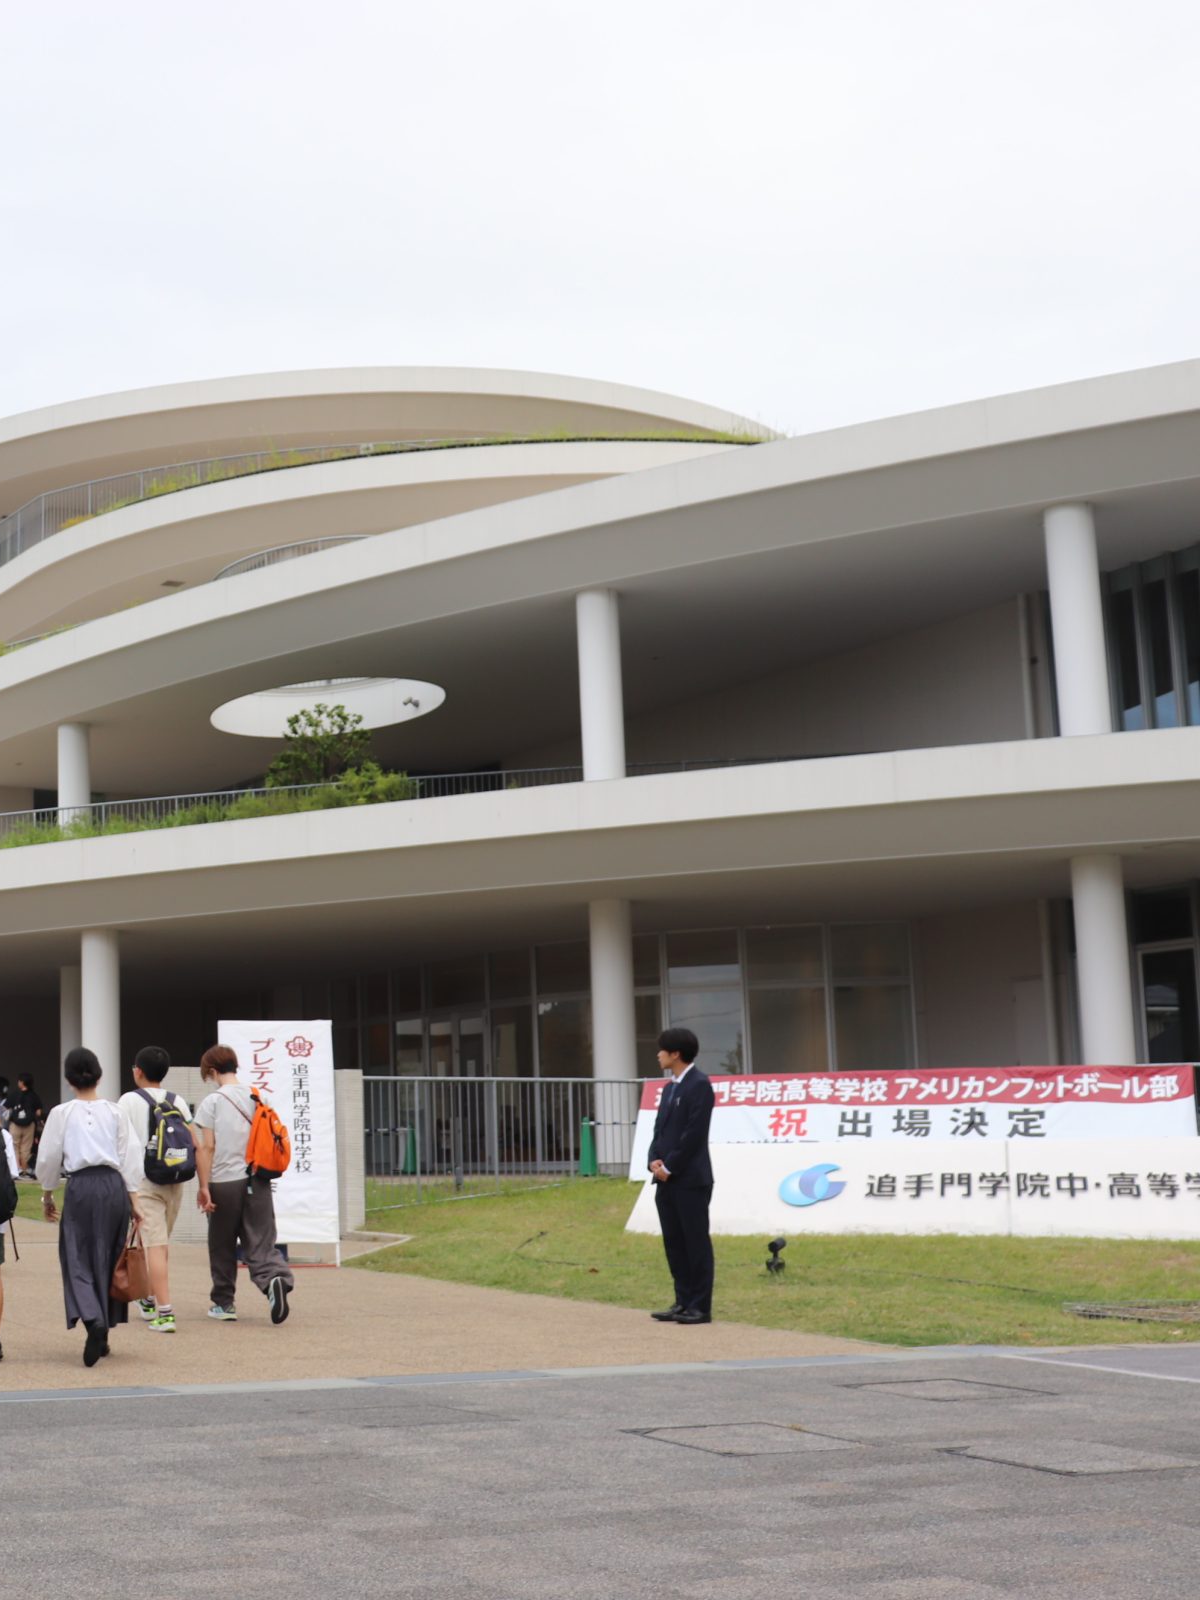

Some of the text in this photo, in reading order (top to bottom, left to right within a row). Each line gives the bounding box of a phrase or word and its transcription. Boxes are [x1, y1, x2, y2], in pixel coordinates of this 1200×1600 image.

[249, 1037, 275, 1095] プレテス
[654, 1073, 1180, 1108] 門学院高等学校 アメリカンフットボール部
[292, 1063, 312, 1173] 追手門学院中学校
[768, 1107, 1047, 1138] 祝 出場決定
